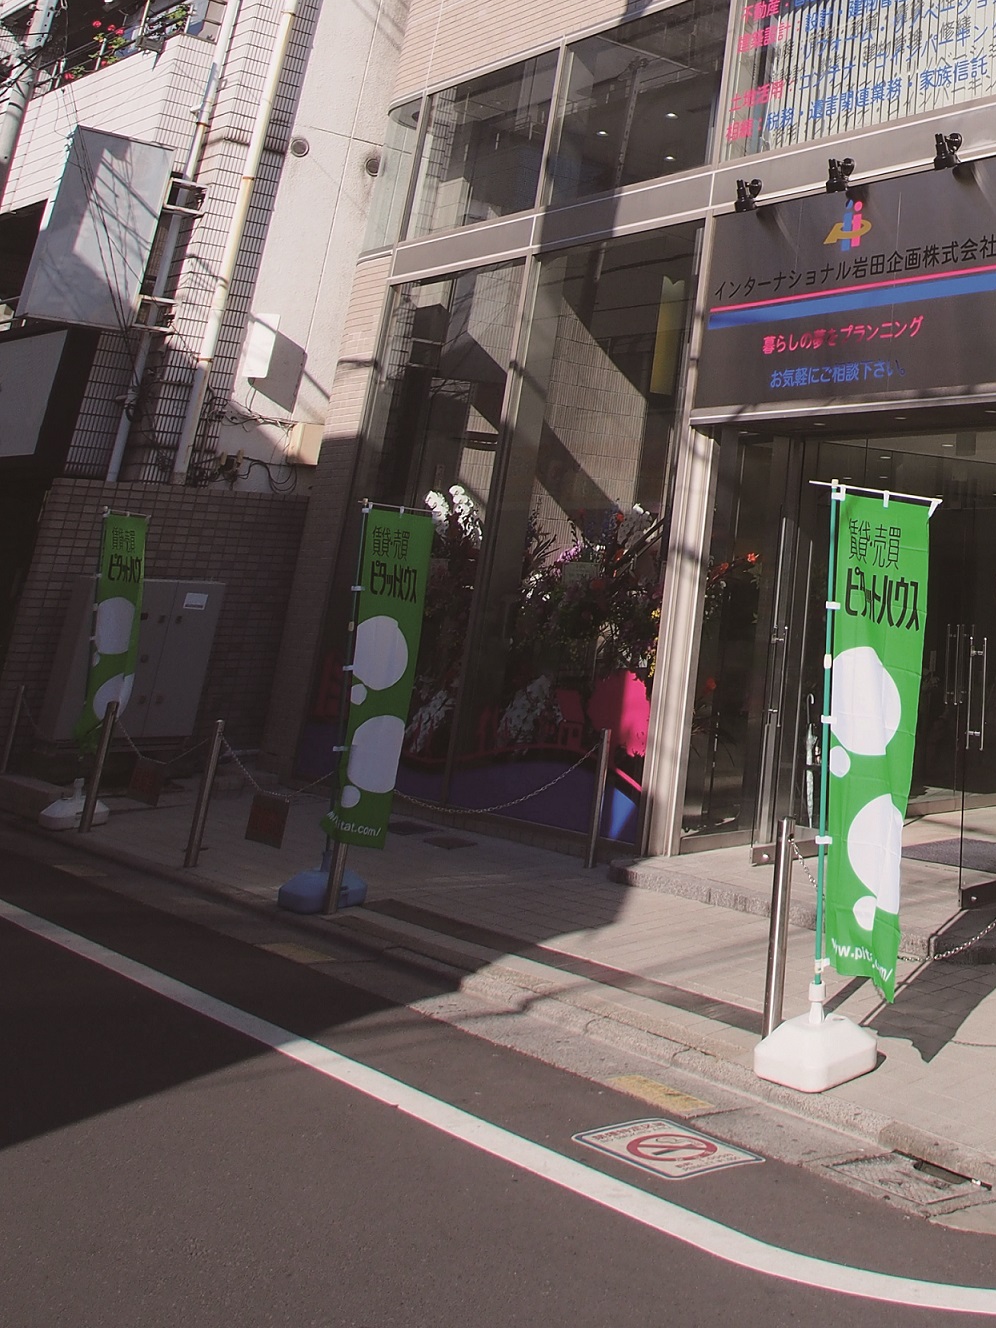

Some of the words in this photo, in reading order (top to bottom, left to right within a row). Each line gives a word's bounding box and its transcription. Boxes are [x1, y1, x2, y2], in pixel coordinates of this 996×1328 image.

[762, 315, 924, 355] 暮らしの夢をプランニング
[848, 517, 902, 570] 賃貸・売買
